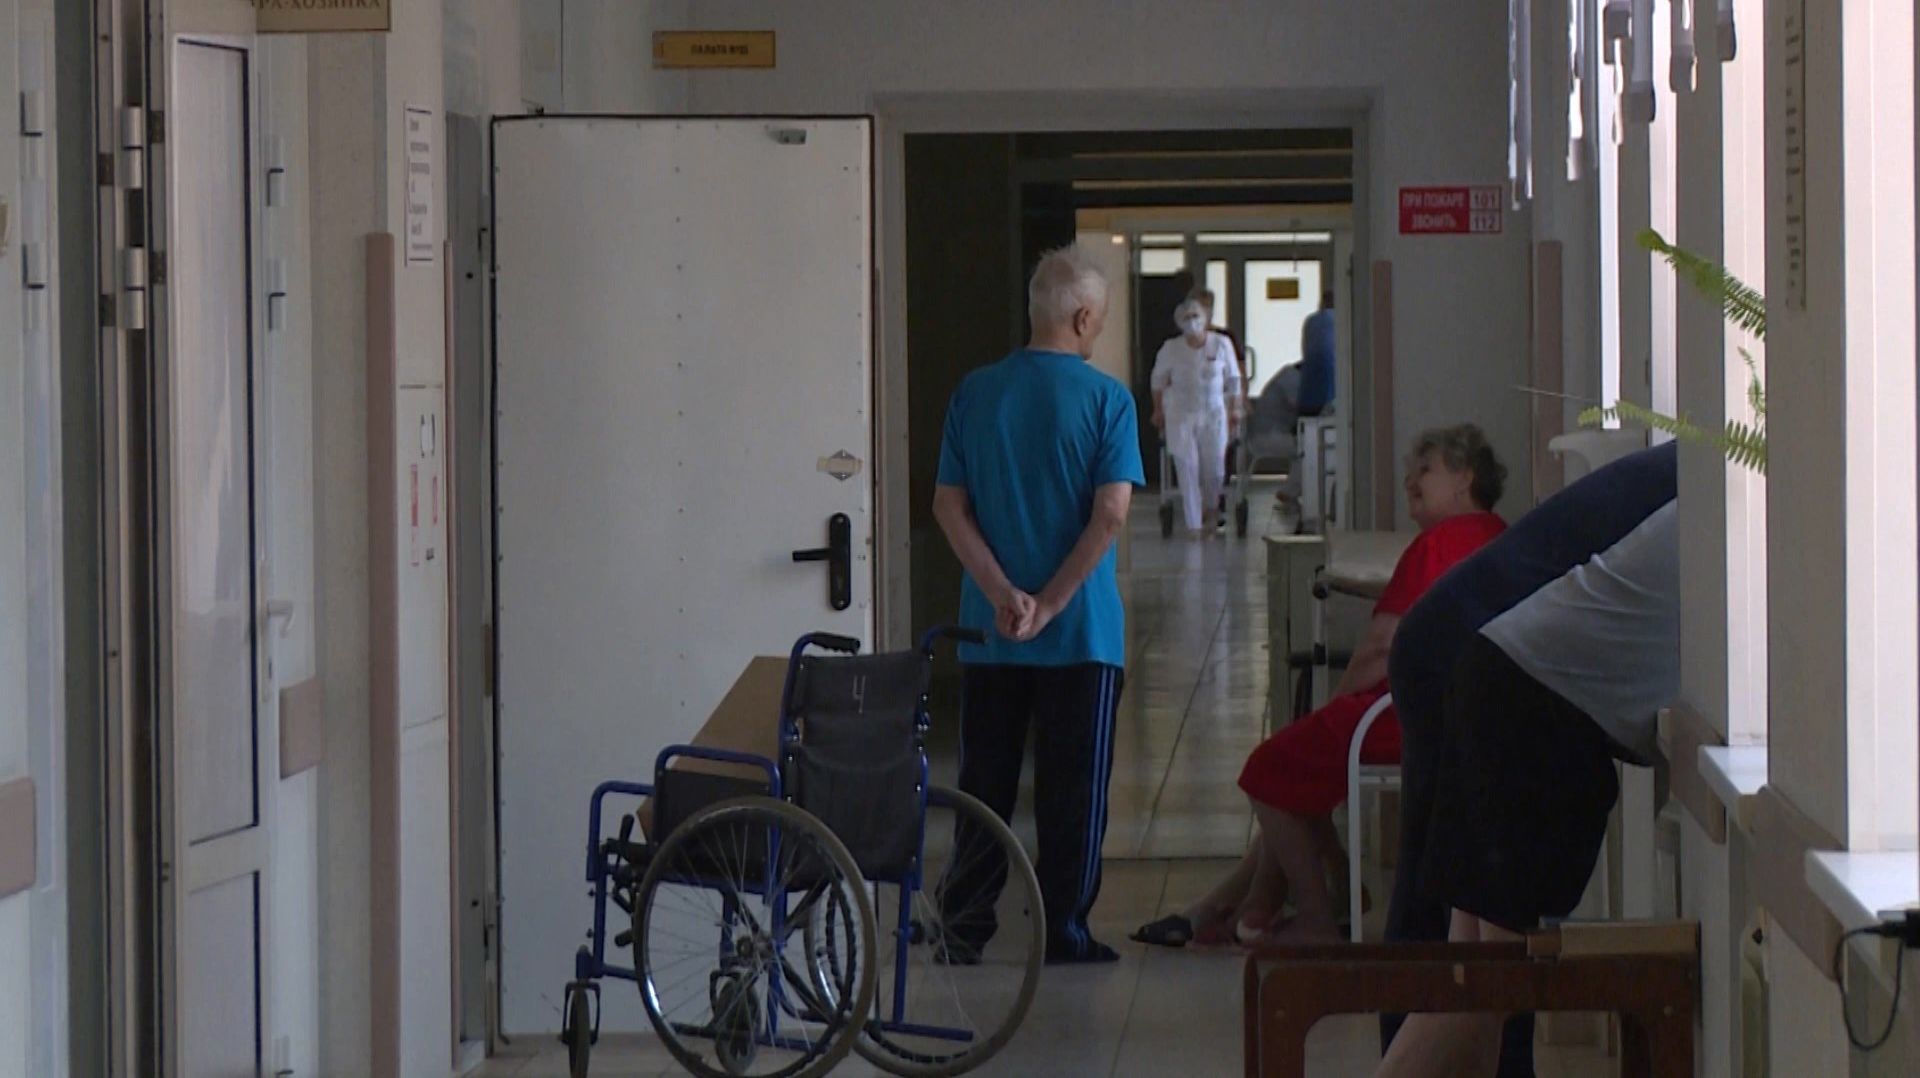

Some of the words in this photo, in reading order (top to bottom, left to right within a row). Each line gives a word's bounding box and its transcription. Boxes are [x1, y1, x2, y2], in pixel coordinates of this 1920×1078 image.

[1403, 192, 1421, 208] ПРИ
[1424, 192, 1464, 208] ПОЖАРЕ
[1474, 192, 1495, 208] 101
[1412, 214, 1456, 229] ЗВОНИТЬ
[1474, 215, 1495, 231] 112
